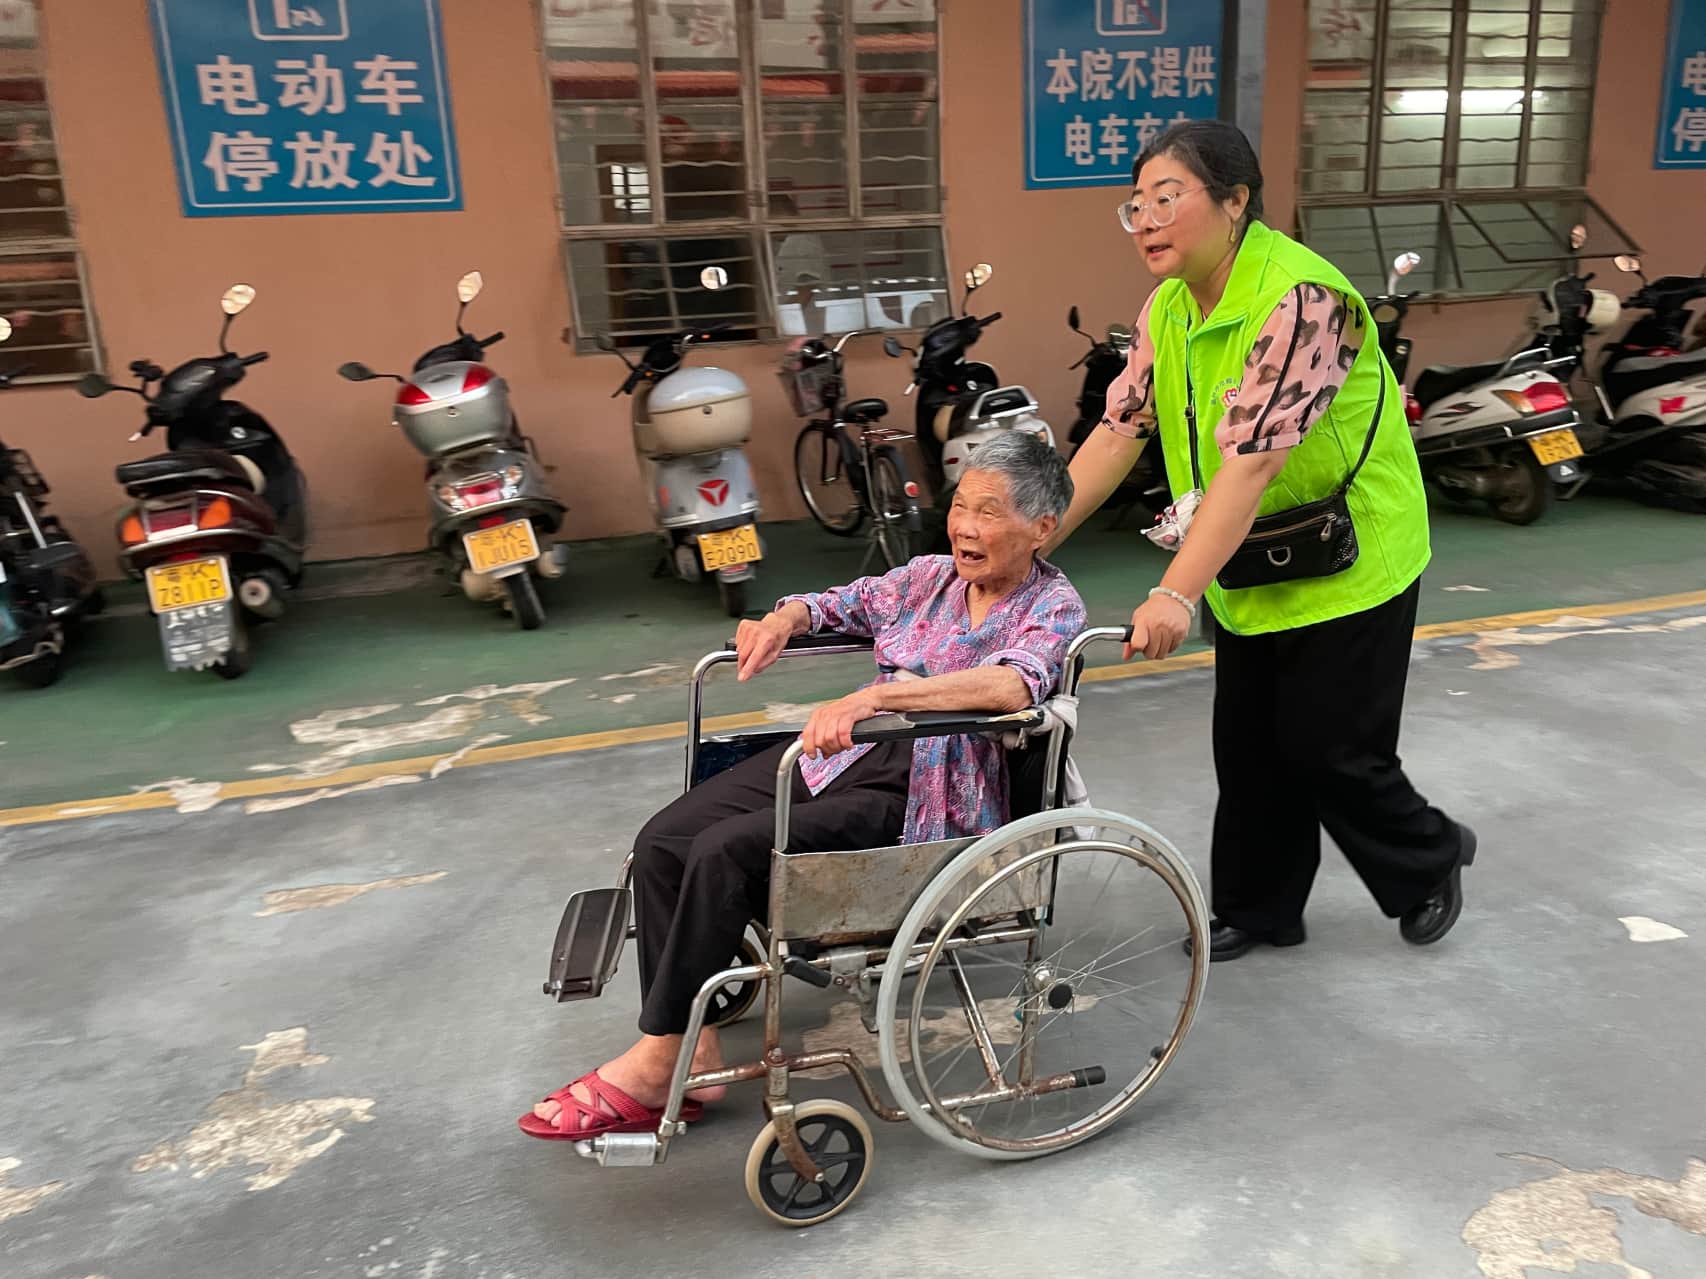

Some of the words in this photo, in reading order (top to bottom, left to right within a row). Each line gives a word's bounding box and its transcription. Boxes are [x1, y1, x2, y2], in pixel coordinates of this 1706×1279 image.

[196, 54, 424, 115] 电动车
[1045, 46, 1216, 103] 本院不提供
[1065, 111, 1192, 165] 电车充
[1672, 106, 1706, 152] 停
[203, 130, 437, 192] 停放处
